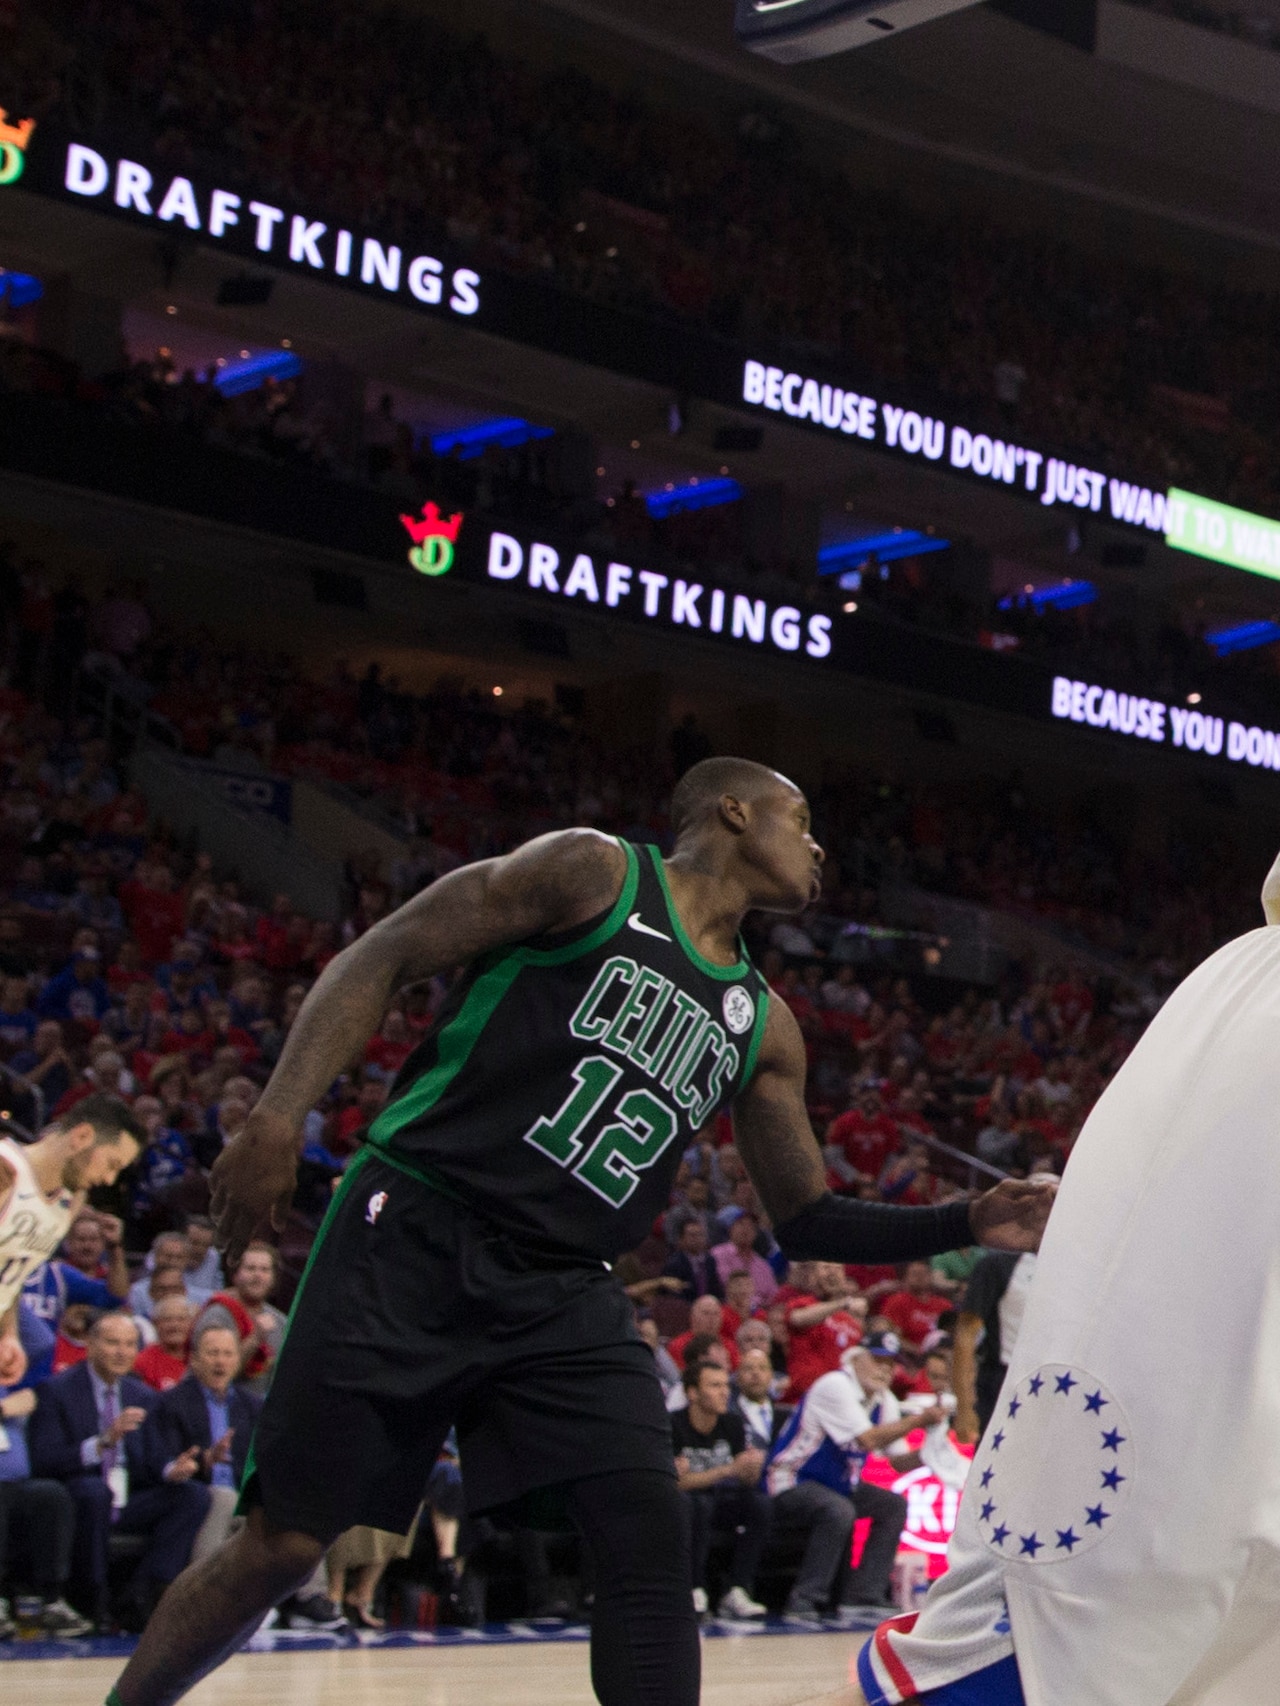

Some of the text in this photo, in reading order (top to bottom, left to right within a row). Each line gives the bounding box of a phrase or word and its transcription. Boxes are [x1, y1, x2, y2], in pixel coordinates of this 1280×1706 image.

[65, 143, 480, 315] DRAFTKINGS
[743, 360, 877, 439] BECAUSE
[882, 404, 945, 460] YOU
[950, 426, 1043, 491] DON'T
[1041, 458, 1106, 512] JUST
[1110, 479, 1188, 538] WANT
[1194, 508, 1226, 550] TO
[488, 532, 833, 658] DRAFTKINGS
[1052, 676, 1166, 742] BECAUSE
[1169, 706, 1224, 755] YOU
[569, 955, 740, 1130] CELTICS
[523, 1055, 678, 1209] 12
[906, 1483, 958, 1534] KI
